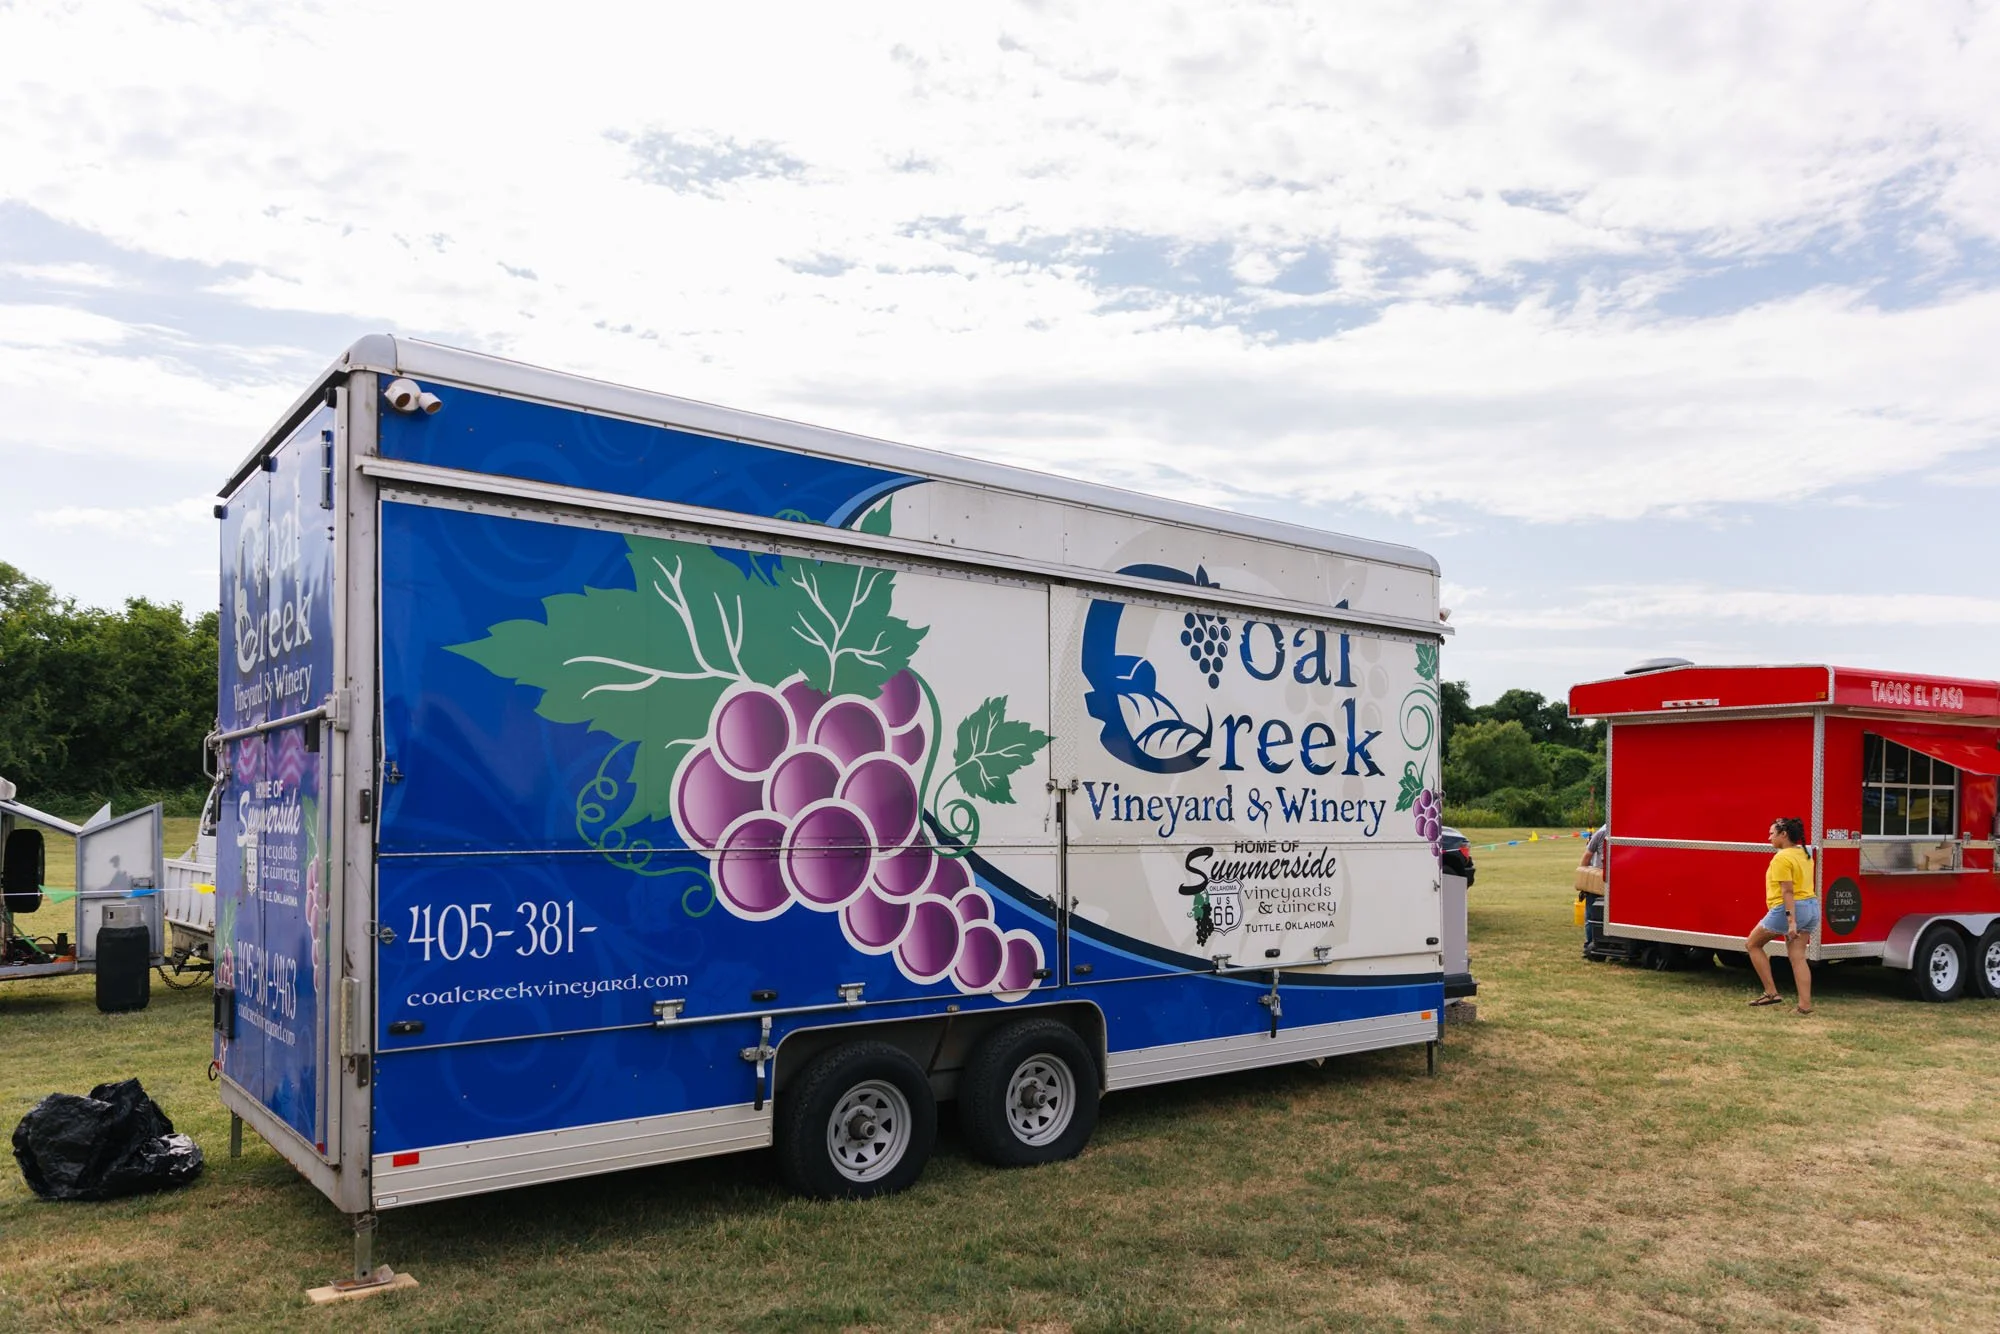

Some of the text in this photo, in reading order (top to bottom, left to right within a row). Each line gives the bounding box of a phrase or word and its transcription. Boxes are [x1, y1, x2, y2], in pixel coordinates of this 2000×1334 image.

[273, 663, 313, 705] Winery
[1871, 681, 1964, 709] TACOS EL PASO
[273, 780, 284, 798] OF
[1082, 781, 1386, 838] Vineyard & Winery
[1234, 840, 1300, 854] HOME OF
[1178, 846, 1337, 896] Summerside
[1244, 883, 1332, 904] vineyards
[1258, 899, 1337, 916] & winery
[1213, 905, 1235, 927] 66
[1284, 920, 1335, 931] OKLAHOMA
[407, 899, 599, 962] 405-381-
[238, 941, 297, 1020] 405-381-9463
[406, 972, 689, 1007] coalcreekvineyard.com
